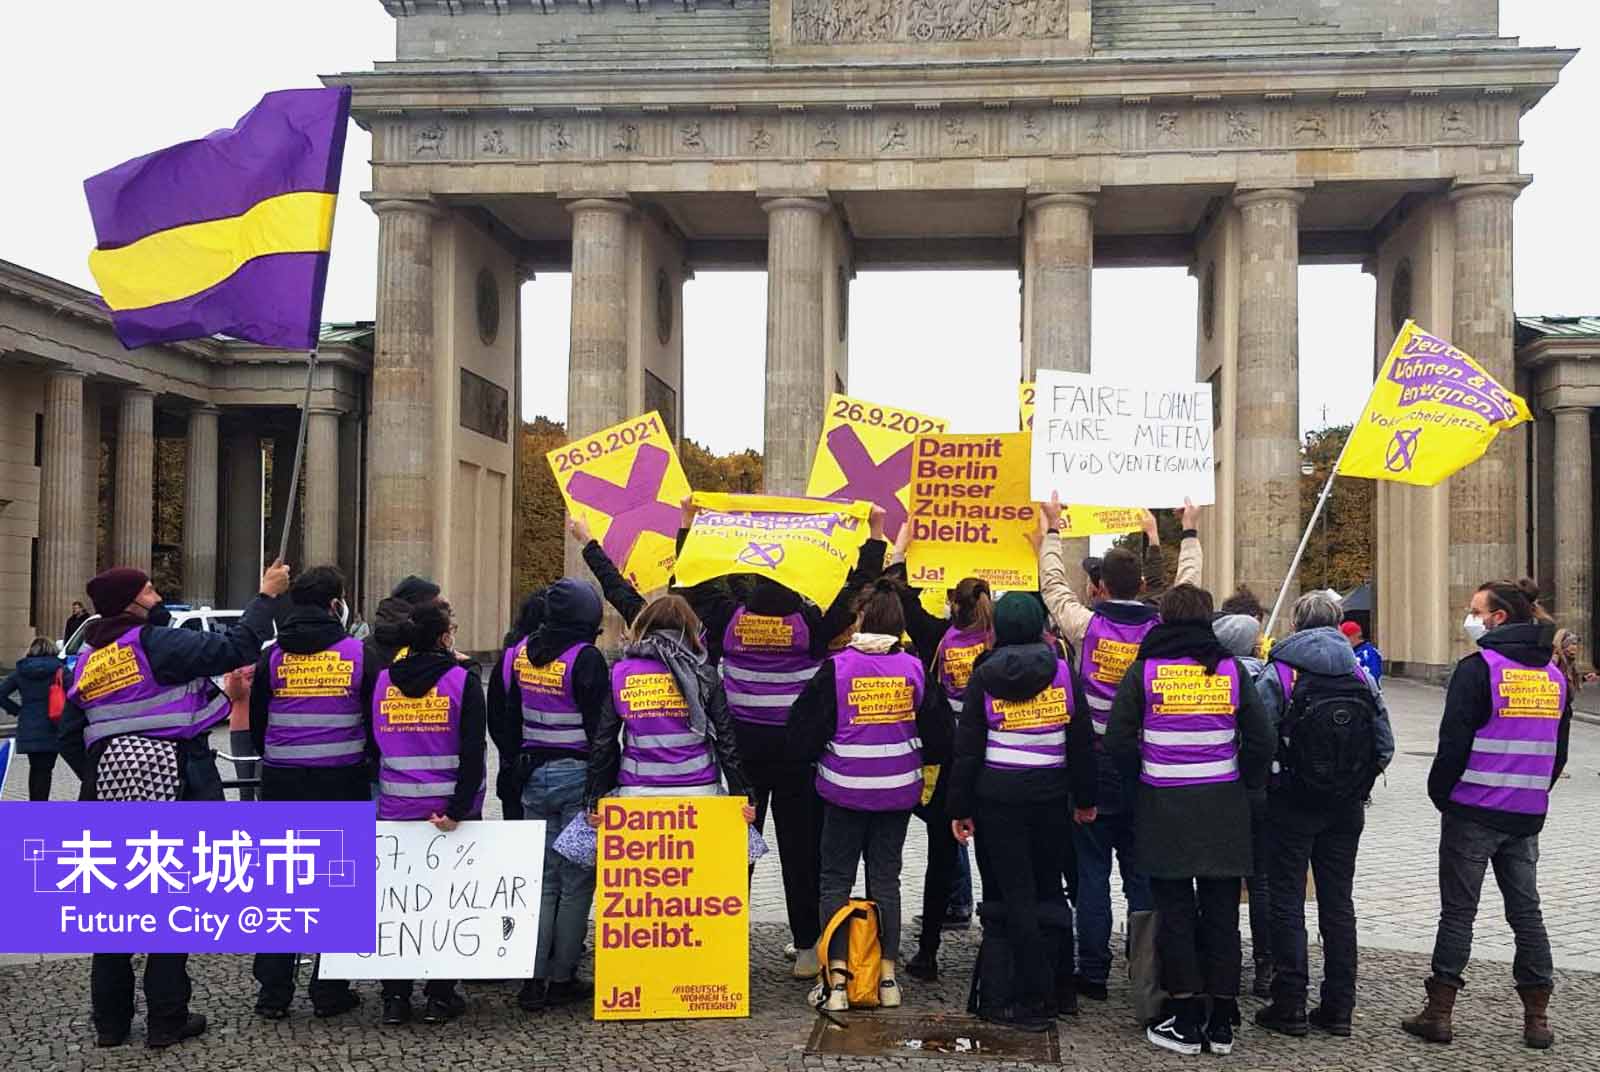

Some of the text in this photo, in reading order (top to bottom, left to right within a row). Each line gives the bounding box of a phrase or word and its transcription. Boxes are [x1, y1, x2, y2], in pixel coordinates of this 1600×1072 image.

[1053, 385, 1133, 416] FAIRE
[834, 400, 945, 434] 26.9.2021
[555, 417, 661, 472] 26.9.2021
[1048, 418, 1211, 450] FAIRE MIETEN
[919, 438, 1003, 458] Damit
[917, 460, 998, 479] Berlin
[915, 482, 995, 498] unser
[914, 499, 1034, 520] Zuhause
[912, 518, 998, 544] bleibt.
[912, 566, 945, 581] Ja!
[622, 688, 665, 699] Wohnen
[854, 679, 904, 689] Deutsche
[1050, 690, 1065, 699] Co
[1153, 681, 1200, 691] Wohnen
[1215, 678, 1229, 687] Co
[849, 692, 892, 703] Wohnen
[603, 804, 698, 831] Damit
[603, 834, 695, 861] Berlin
[603, 866, 694, 888] unser
[380, 875, 527, 913] IND KLAR
[602, 891, 743, 918] Zuhause
[357, 916, 480, 958] ENUG
[602, 922, 702, 949] bleibt.
[602, 986, 641, 1009] Ja!
